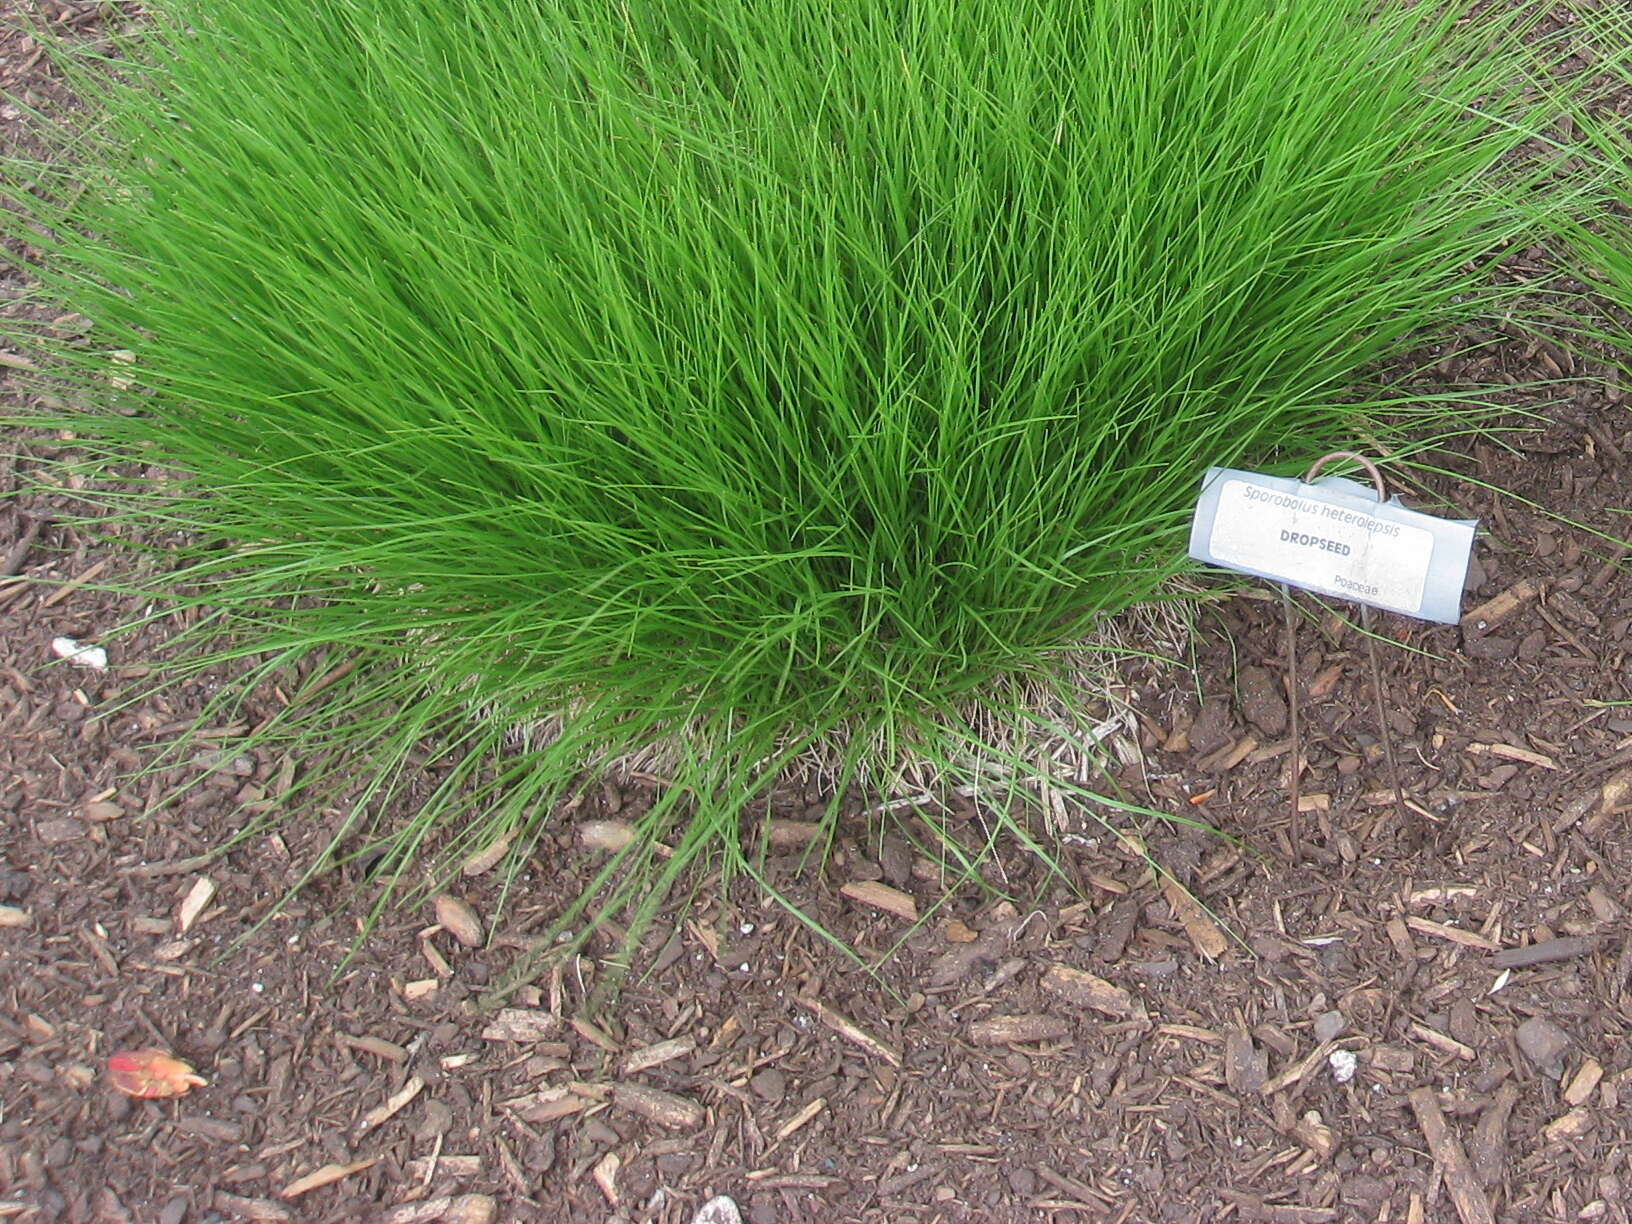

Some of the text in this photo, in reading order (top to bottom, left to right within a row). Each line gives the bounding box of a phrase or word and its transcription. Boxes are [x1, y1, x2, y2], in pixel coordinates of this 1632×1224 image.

[1243, 485, 1318, 515] Sporobolus
[1279, 529, 1351, 557] DROPSEED
[1334, 575, 1379, 597] Poaceae
